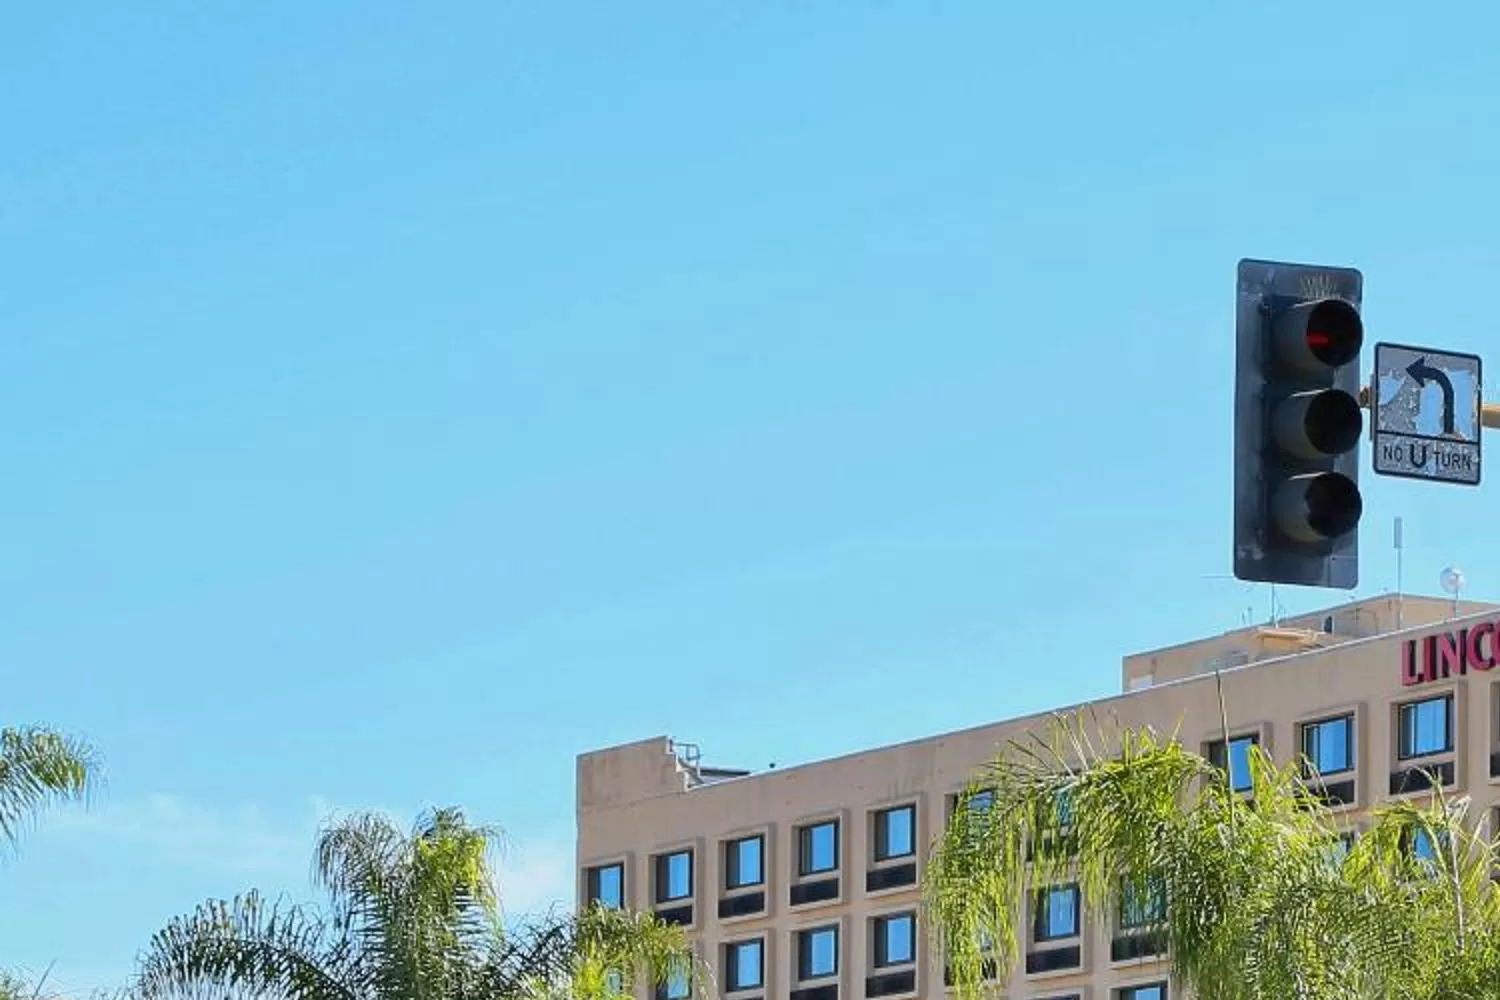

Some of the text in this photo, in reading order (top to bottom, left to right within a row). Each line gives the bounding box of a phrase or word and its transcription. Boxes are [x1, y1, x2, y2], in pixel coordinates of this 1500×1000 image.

[1383, 443, 1473, 471] NO U TURN
